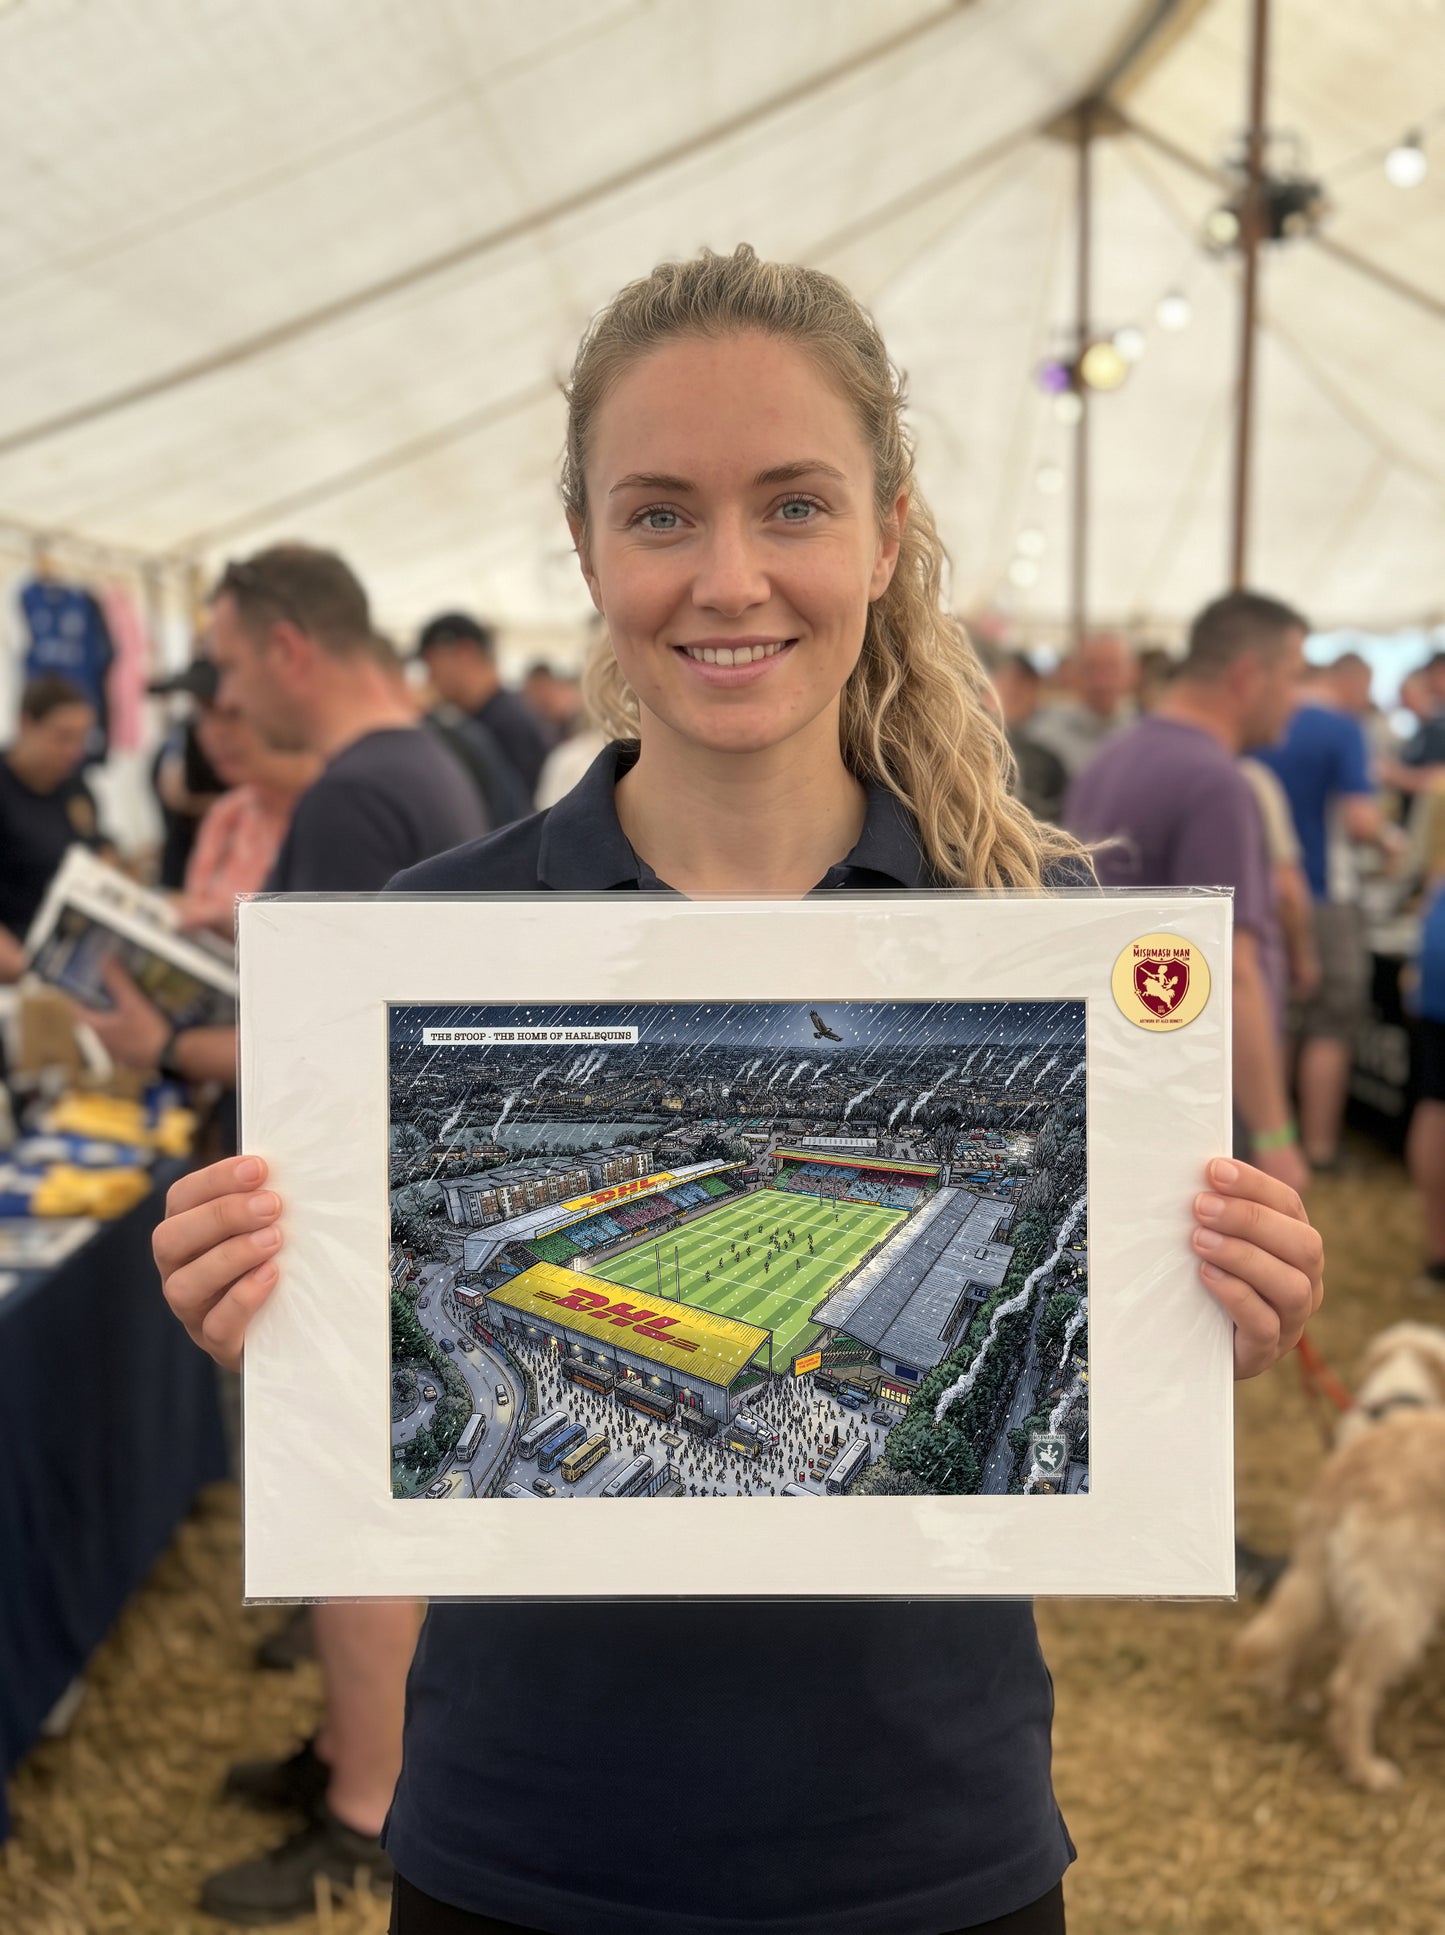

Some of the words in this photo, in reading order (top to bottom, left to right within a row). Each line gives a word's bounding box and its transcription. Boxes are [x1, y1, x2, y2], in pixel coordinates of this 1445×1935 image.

[1133, 949, 1171, 957] MISHMASH
[1173, 949, 1190, 957] MAN
[430, 1033, 452, 1041] THE
[454, 1033, 486, 1041] STOOP
[493, 1032, 515, 1040] THE
[517, 1032, 548, 1040] HOME
[549, 1032, 563, 1040] OF
[565, 1031, 632, 1041] HARLEQUINS
[591, 1179, 657, 1203] DHL
[552, 1288, 681, 1342] DHL
